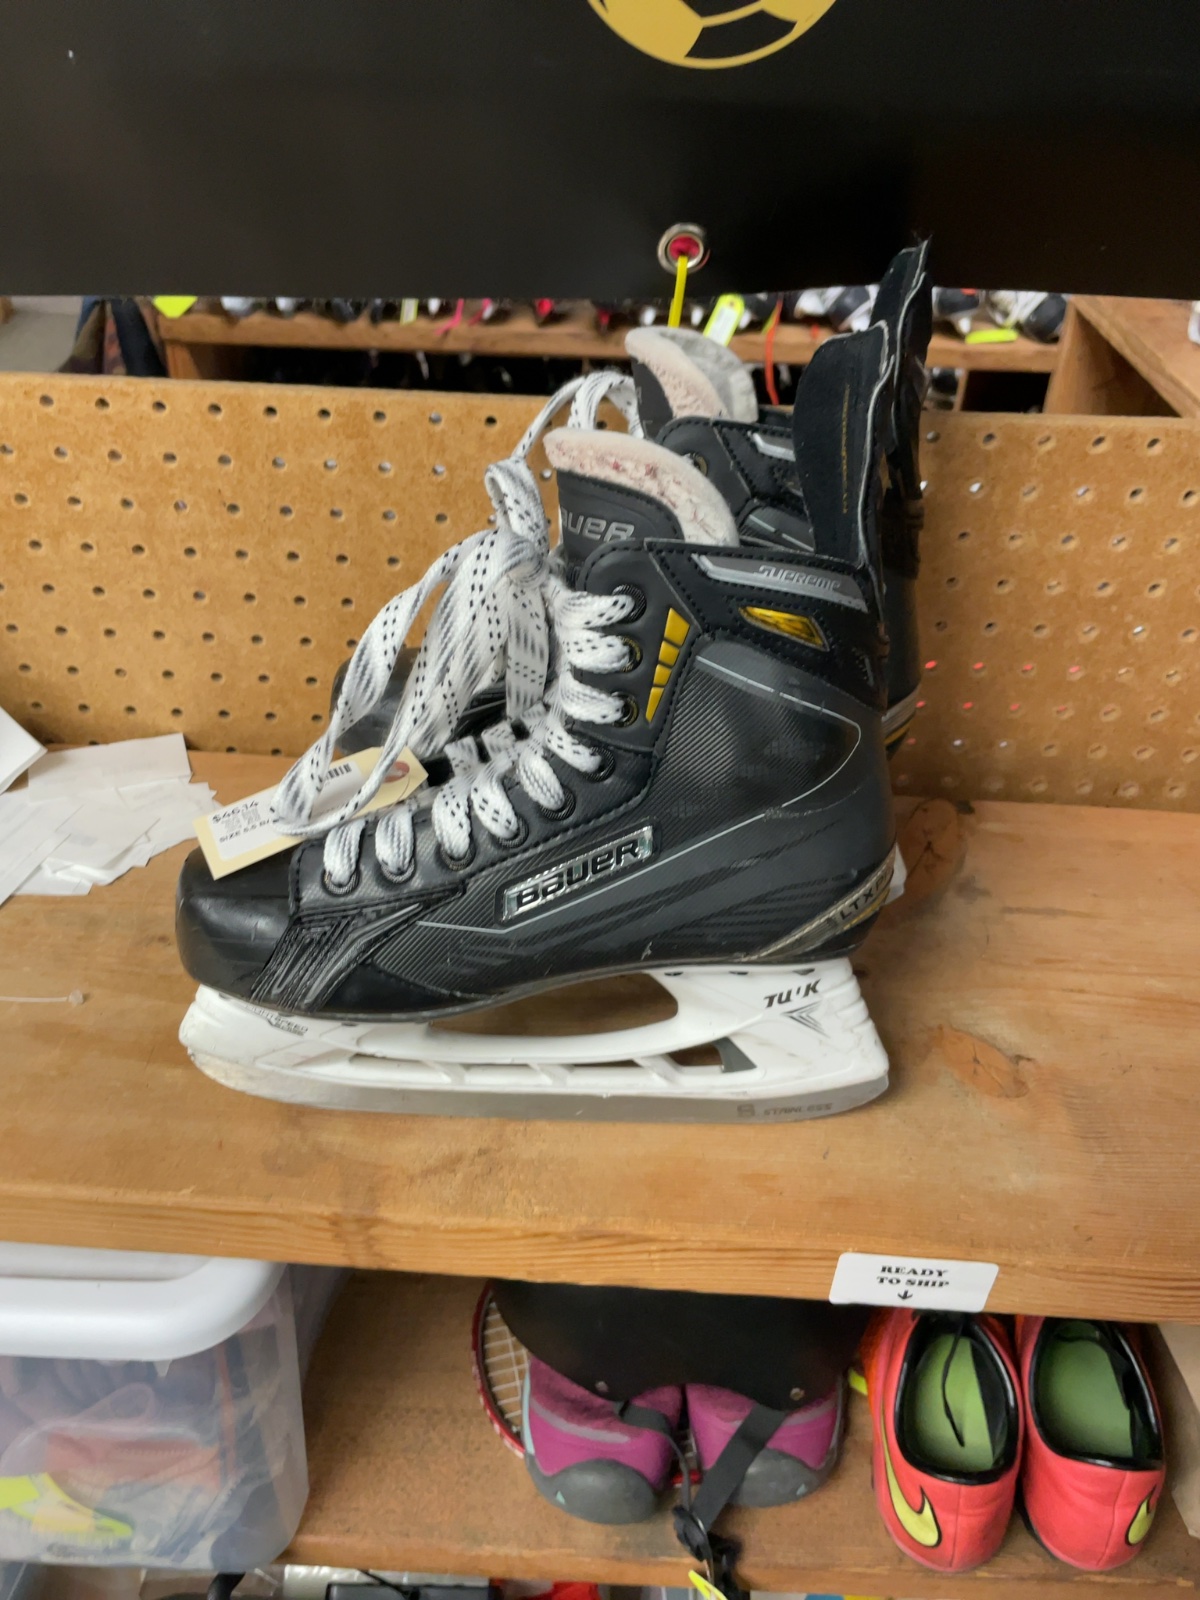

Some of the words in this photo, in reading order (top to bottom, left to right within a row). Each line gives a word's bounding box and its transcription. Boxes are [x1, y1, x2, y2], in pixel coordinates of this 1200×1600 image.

[758, 565, 841, 591] SUPREME
[219, 830, 241, 843] SIZE
[516, 838, 641, 911] BAUER
[880, 1265, 949, 1278] READY
[876, 1276, 901, 1285] TO
[905, 1279, 950, 1288] SHIP
